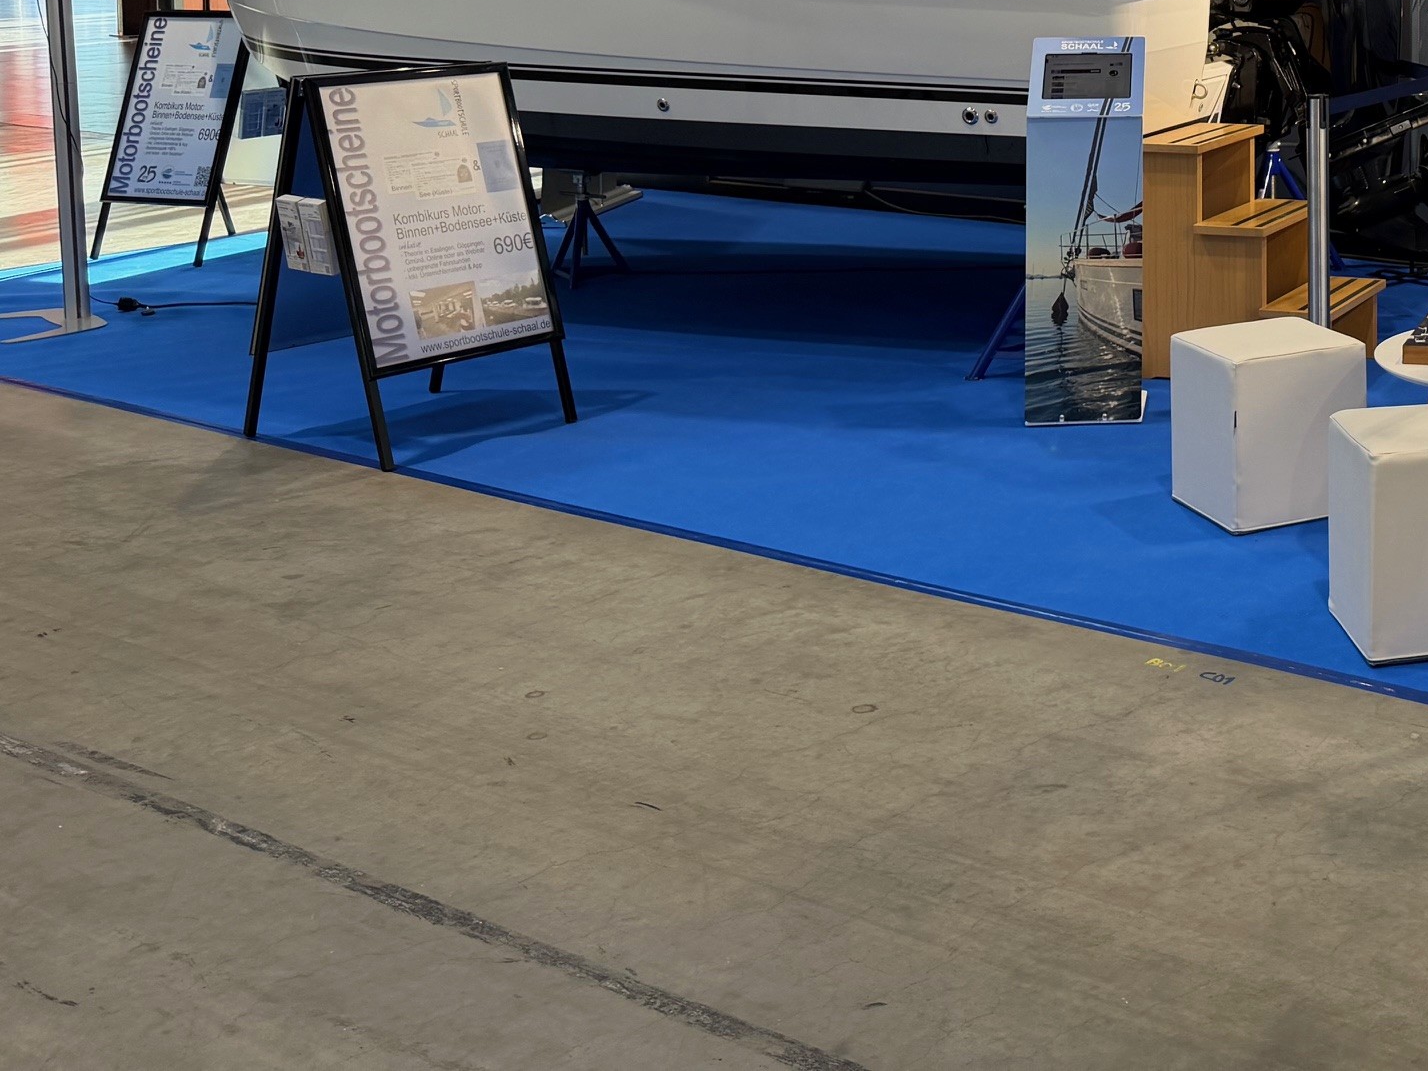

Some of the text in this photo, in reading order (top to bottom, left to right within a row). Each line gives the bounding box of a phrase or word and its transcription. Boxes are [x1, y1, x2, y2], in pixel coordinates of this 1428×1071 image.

[109, 16, 168, 195] Motorbootscheine
[1114, 102, 1131, 112] 25
[137, 165, 157, 183] 25
[473, 160, 481, 171] &
[329, 86, 410, 364] Motorbootscheine
[393, 204, 486, 225] Kombikurs Motor:
[396, 211, 527, 240] Binnen+Bodensee+Küste
[493, 232, 534, 255] 690€
[421, 319, 551, 354] www.sportbootschule-schaal.de
[1200, 672, 1236, 685] C01
